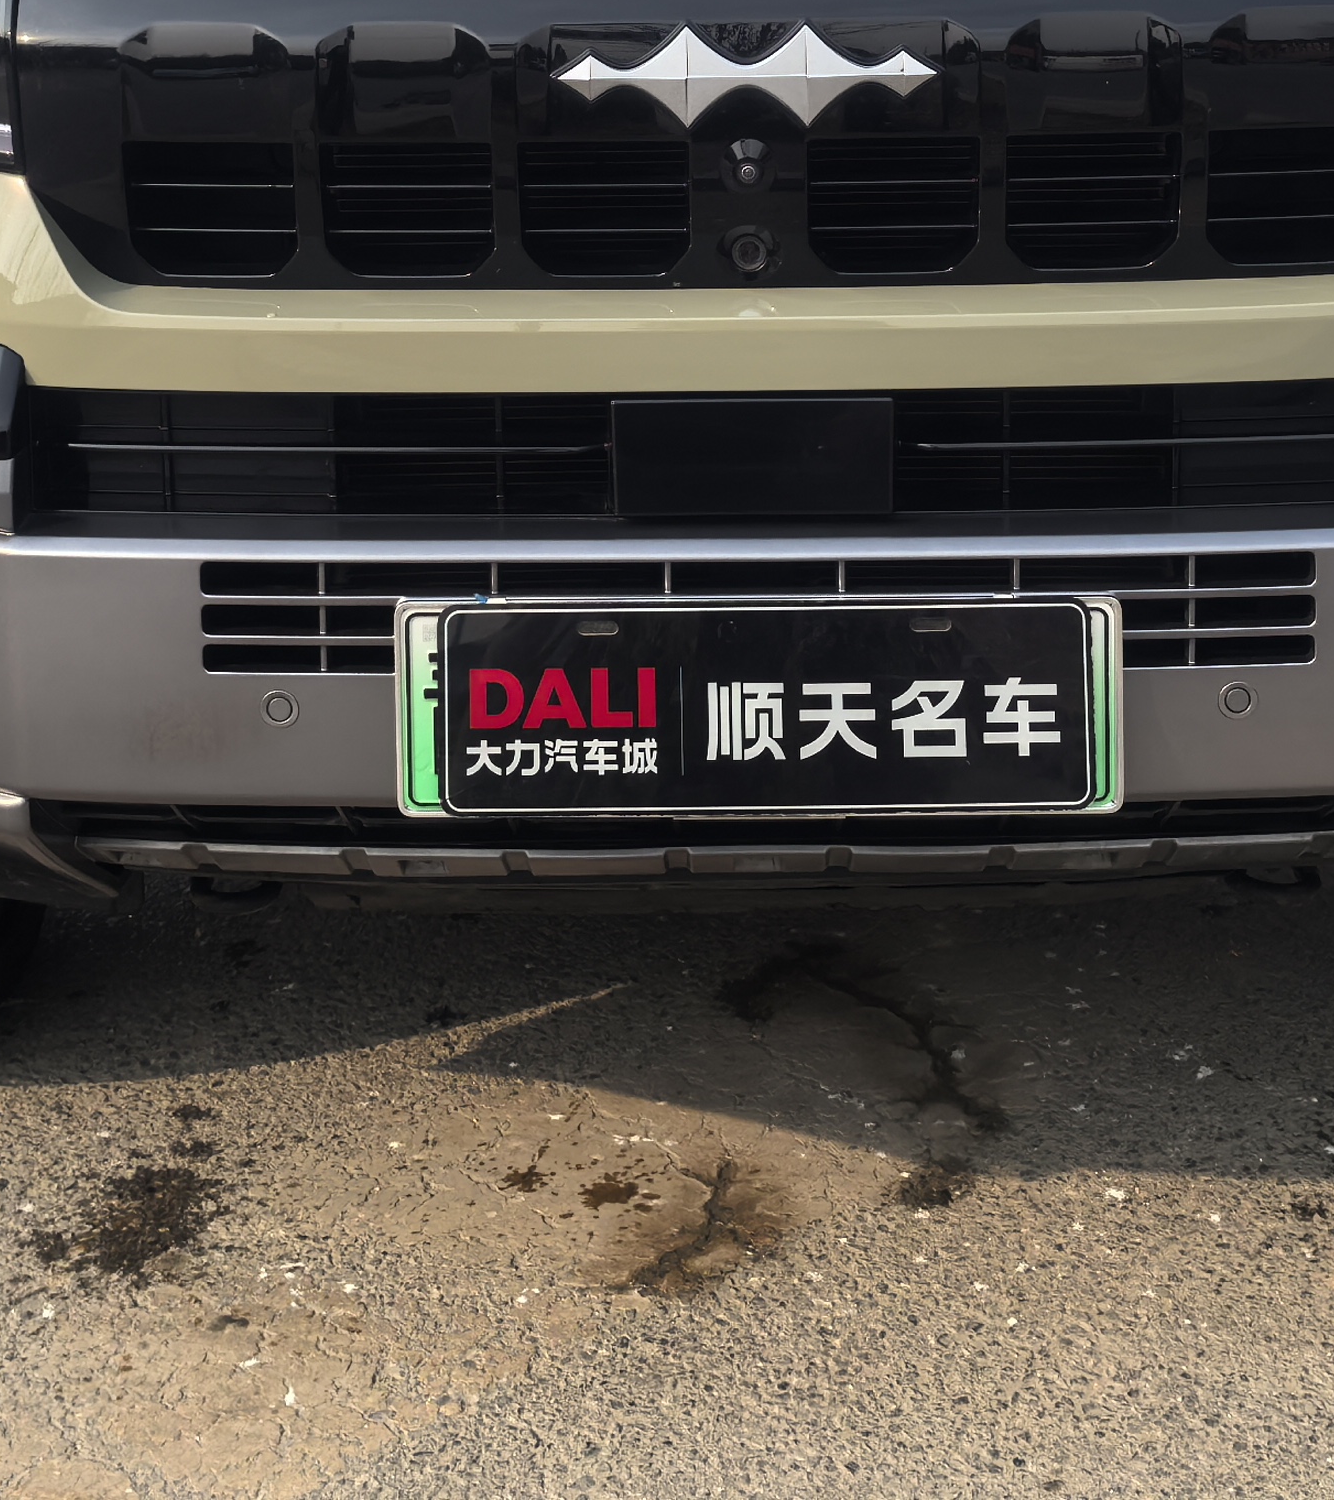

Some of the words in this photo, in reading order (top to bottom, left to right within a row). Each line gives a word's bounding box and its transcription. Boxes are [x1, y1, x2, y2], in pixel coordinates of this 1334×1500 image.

[468, 667, 657, 729] DALI
[706, 677, 1062, 760] 顺天名车
[466, 739, 659, 776] 大力汽车城
